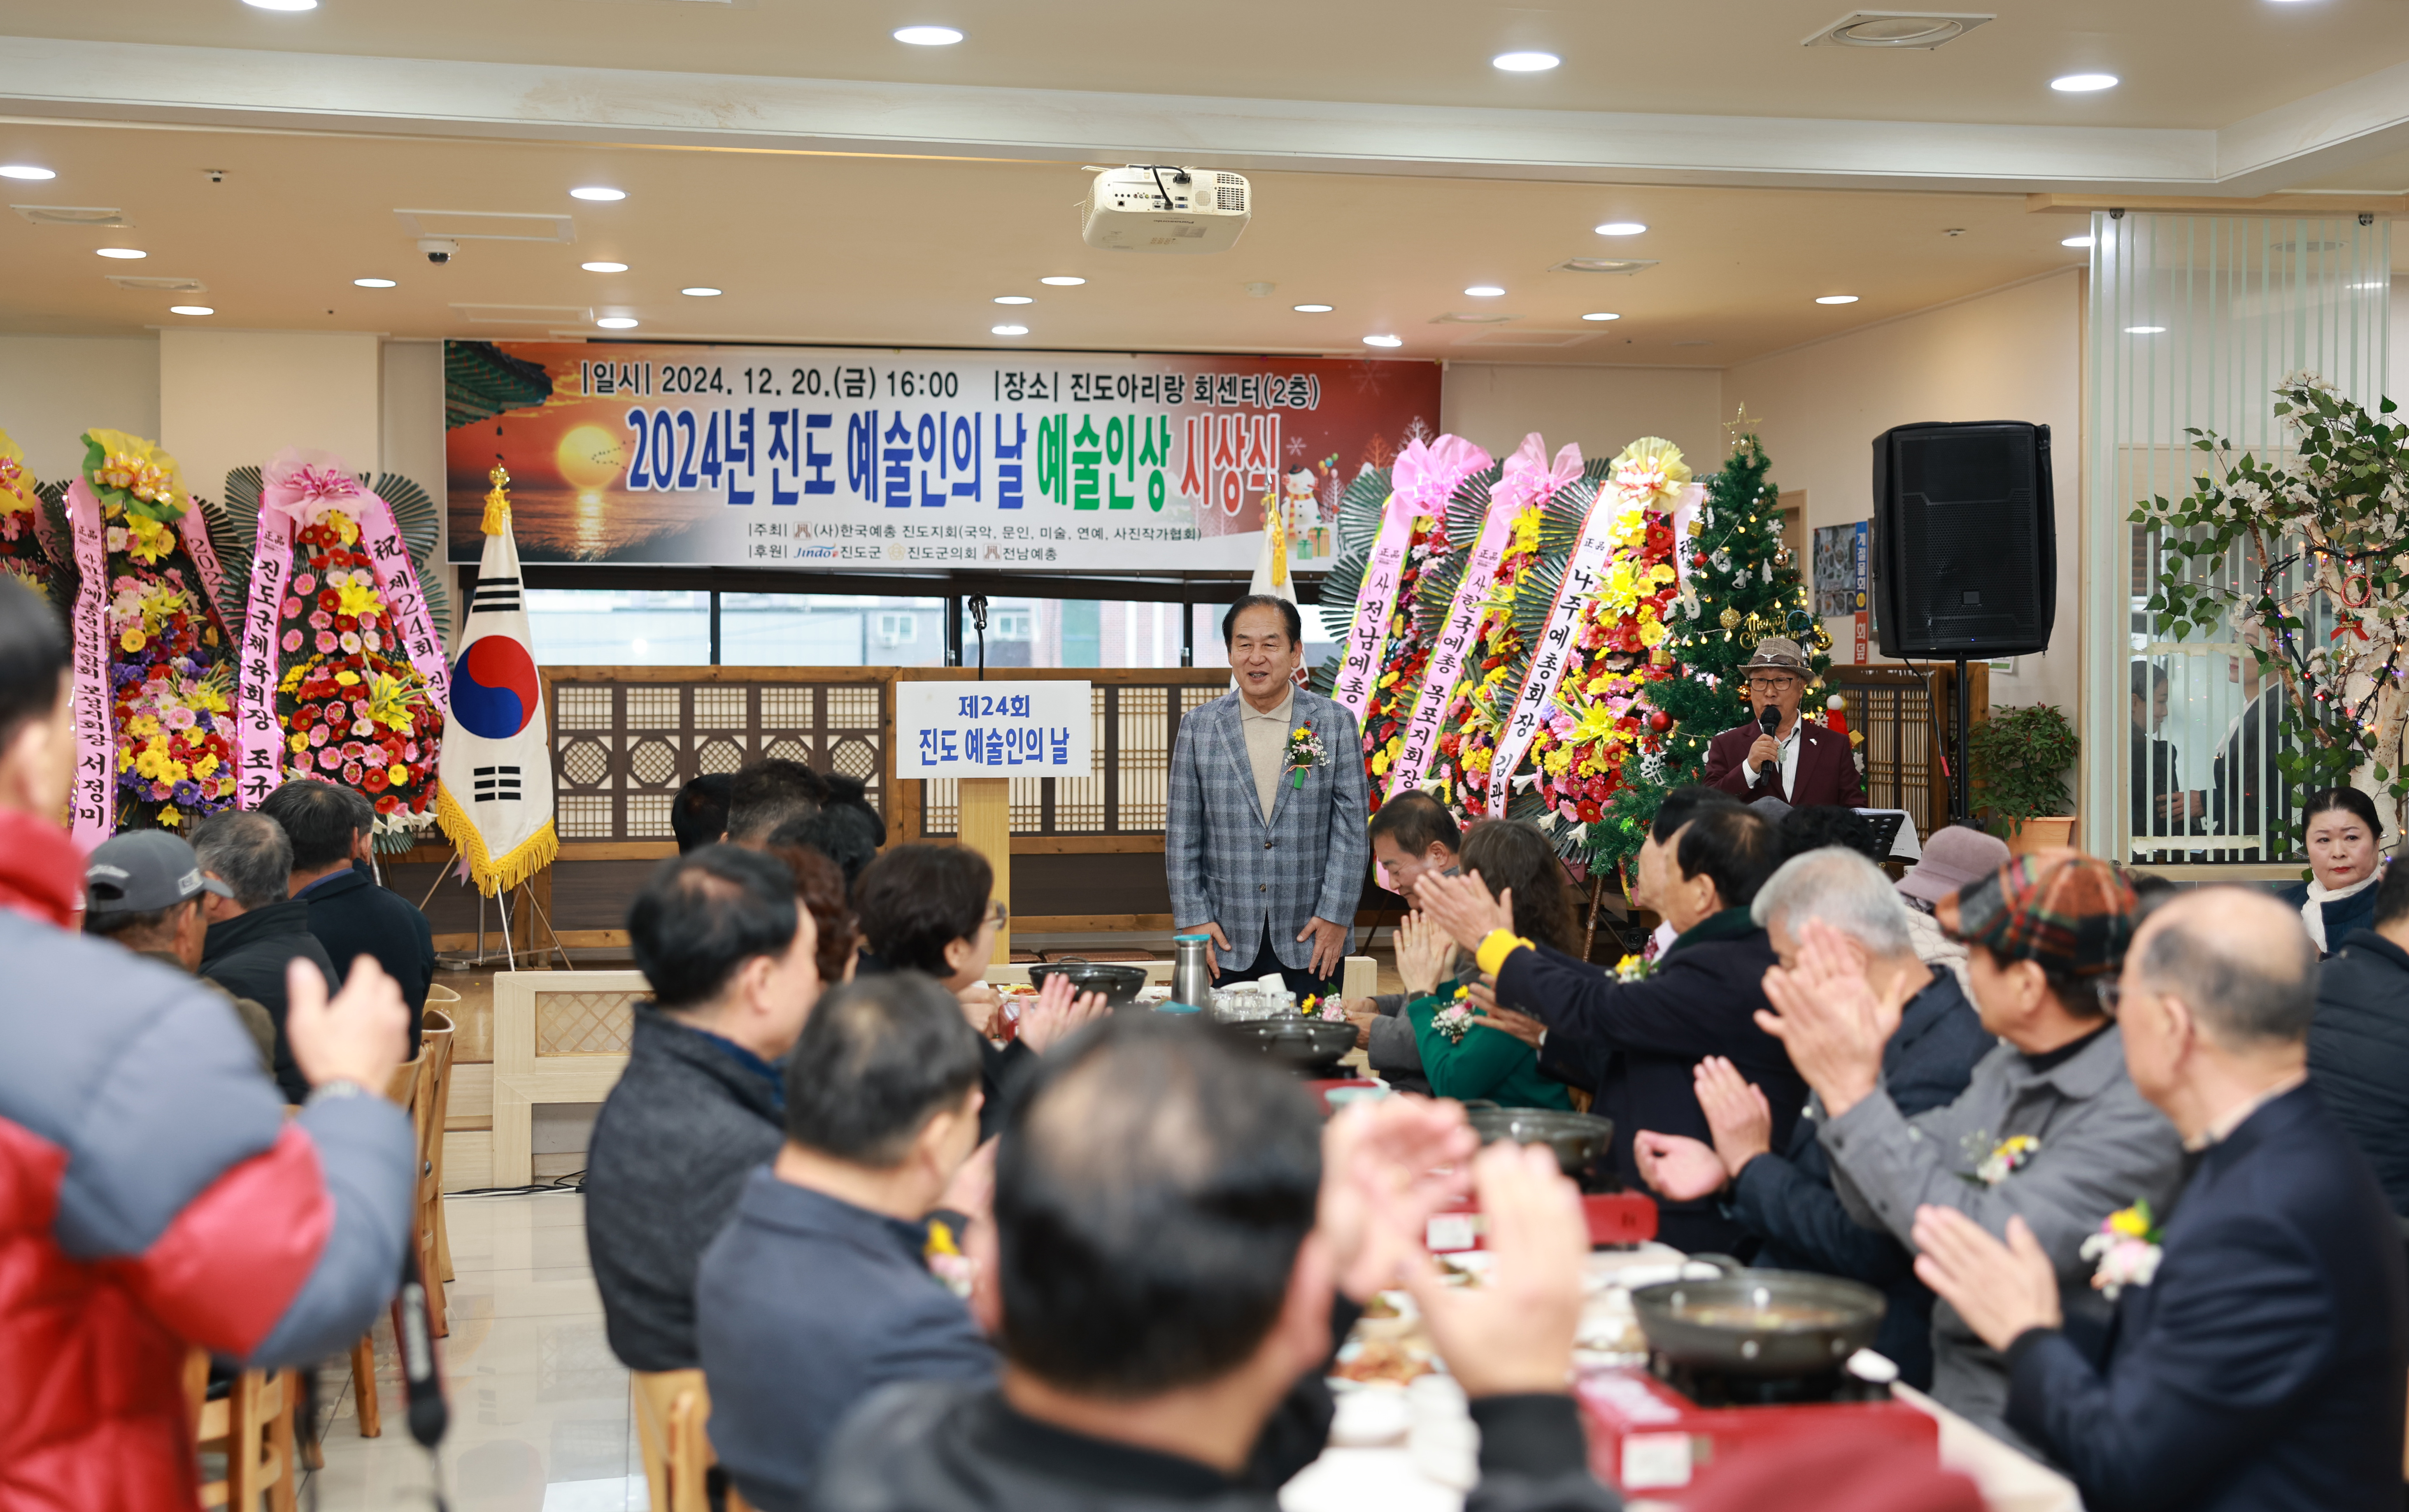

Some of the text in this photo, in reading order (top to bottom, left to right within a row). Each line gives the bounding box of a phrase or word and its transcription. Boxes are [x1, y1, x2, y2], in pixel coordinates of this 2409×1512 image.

[662, 366, 733, 395] 2024.
[745, 368, 782, 396] 12.
[792, 366, 876, 400] 20.(금)
[888, 371, 958, 398] 16:00
[1071, 373, 1185, 404] 진도아리랑
[1194, 375, 1319, 409] 회센터(2층)
[628, 407, 1280, 516] 2024년 진도 예술인의 날 예술인상 시상식
[374, 535, 403, 561] 祝
[794, 546, 832, 559] Jindo
[840, 546, 882, 559] 진도군
[908, 547, 977, 560] 진도군의회
[1003, 547, 1057, 561] 전남예총
[815, 523, 896, 538] (사)한국예총
[903, 525, 996, 540] 진도지회(국악,
[1003, 526, 1033, 540] 문인,
[1040, 527, 1071, 540] 미술,
[1078, 527, 1108, 541] 연예,
[1114, 527, 1202, 542] 사진작가협회)
[1857, 533, 1867, 591] 계절물회
[388, 570, 434, 658] 제24회
[243, 559, 279, 731] 진도군체육회장
[958, 694, 1030, 719] 제24회
[1490, 565, 1594, 820] 나주예총회장 김관
[919, 727, 1070, 766] 진도 예술인의 날
[1398, 684, 1445, 789] 목포지회장
[80, 752, 106, 828] 서정미
